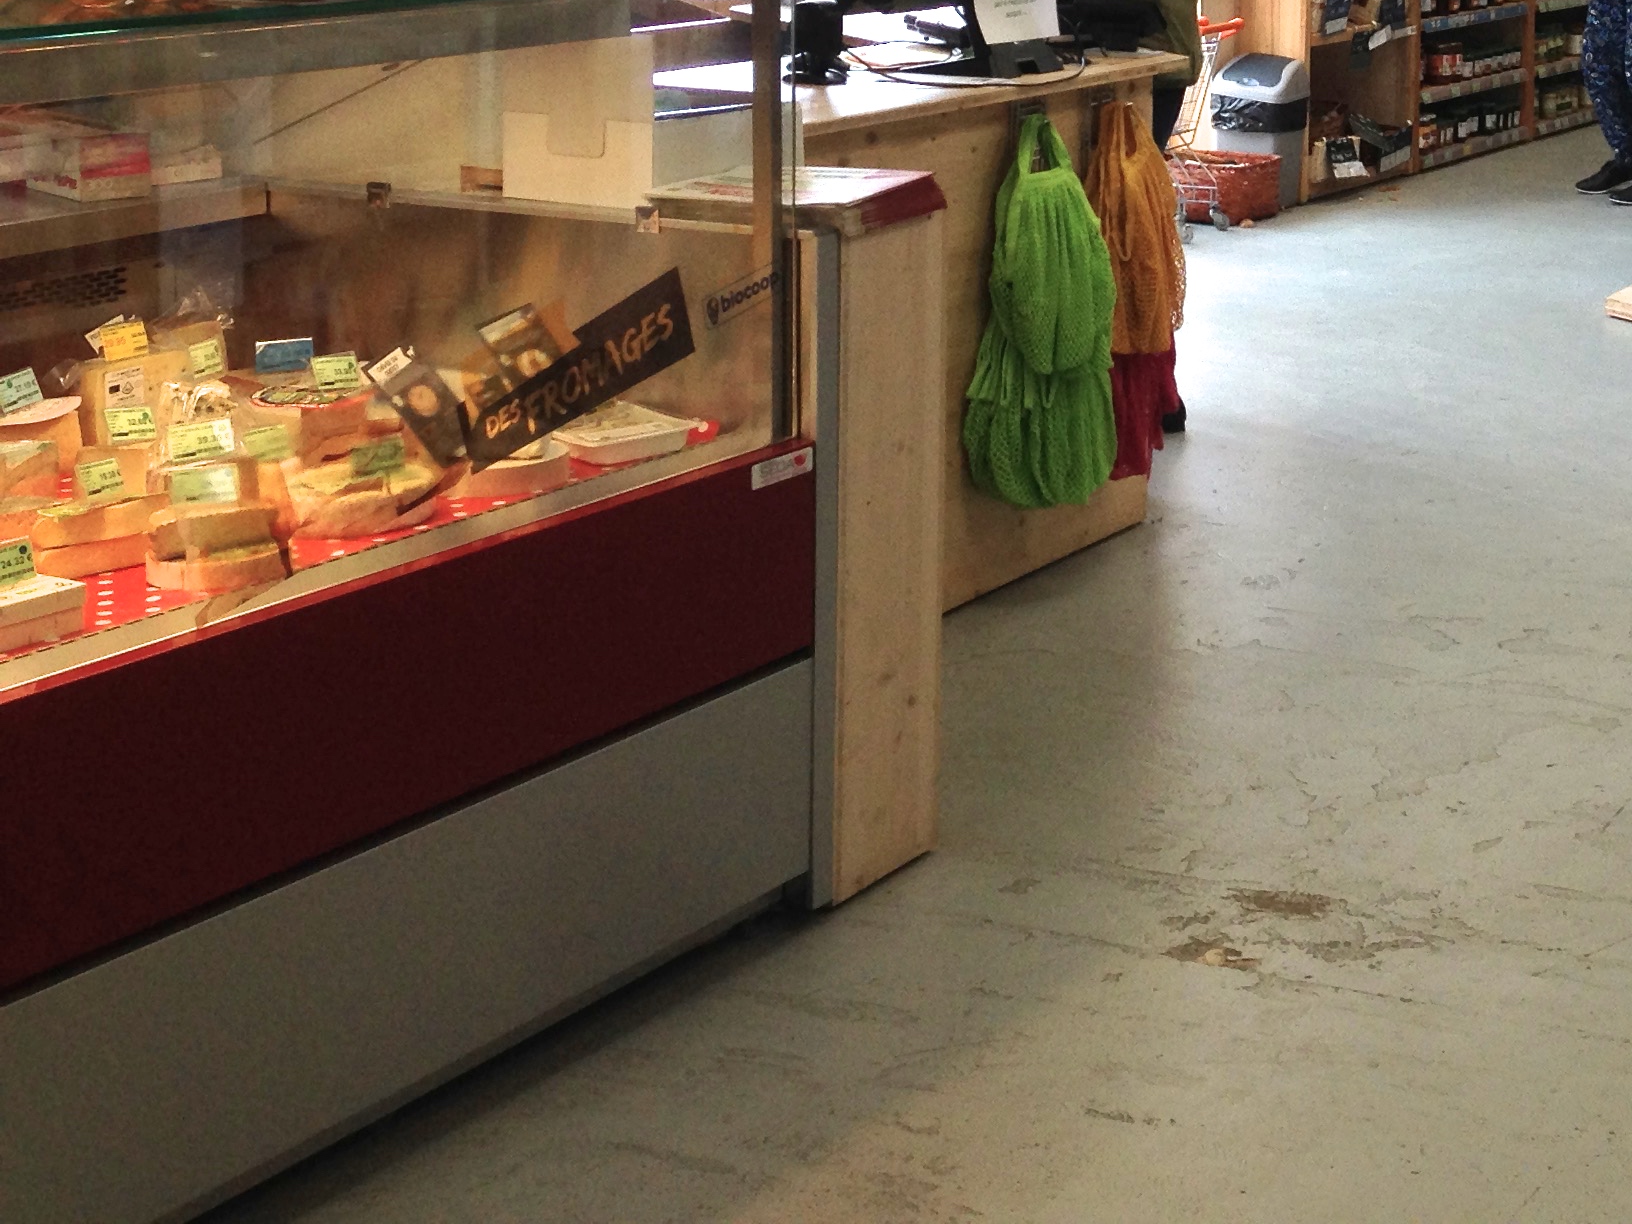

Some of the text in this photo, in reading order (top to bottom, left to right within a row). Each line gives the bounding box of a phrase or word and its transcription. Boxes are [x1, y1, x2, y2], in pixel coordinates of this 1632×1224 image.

[720, 270, 780, 314] biocoop
[484, 302, 675, 440] DES FROMAGES
